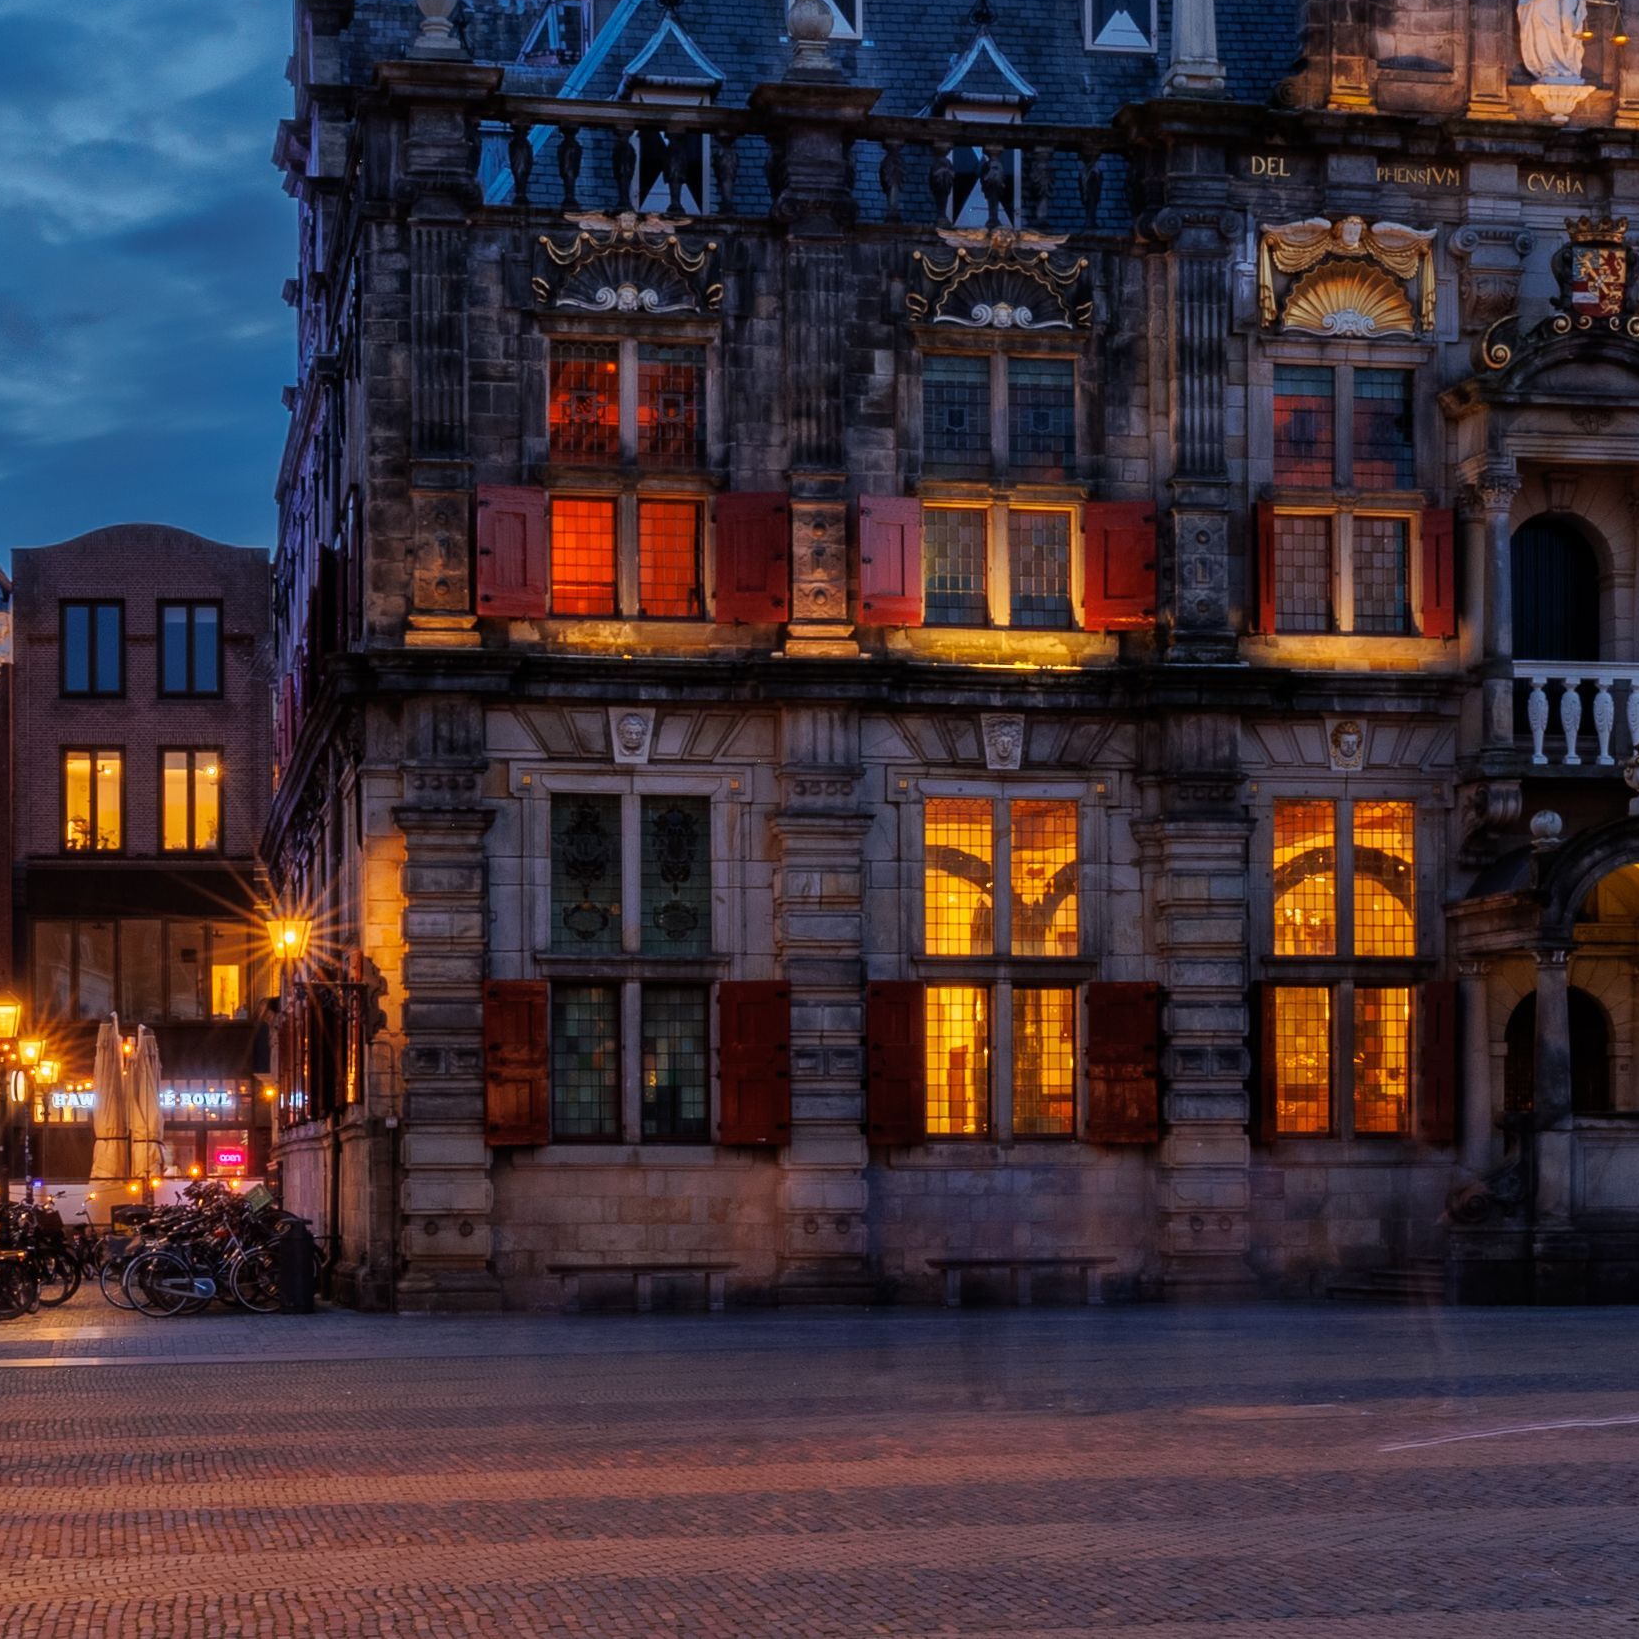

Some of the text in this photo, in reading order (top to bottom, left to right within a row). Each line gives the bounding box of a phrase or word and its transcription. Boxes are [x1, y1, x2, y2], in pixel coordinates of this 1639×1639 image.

[1251, 156, 1291, 177] DEL
[53, 1092, 95, 1108] HAW
[180, 1092, 233, 1106] BOWL
